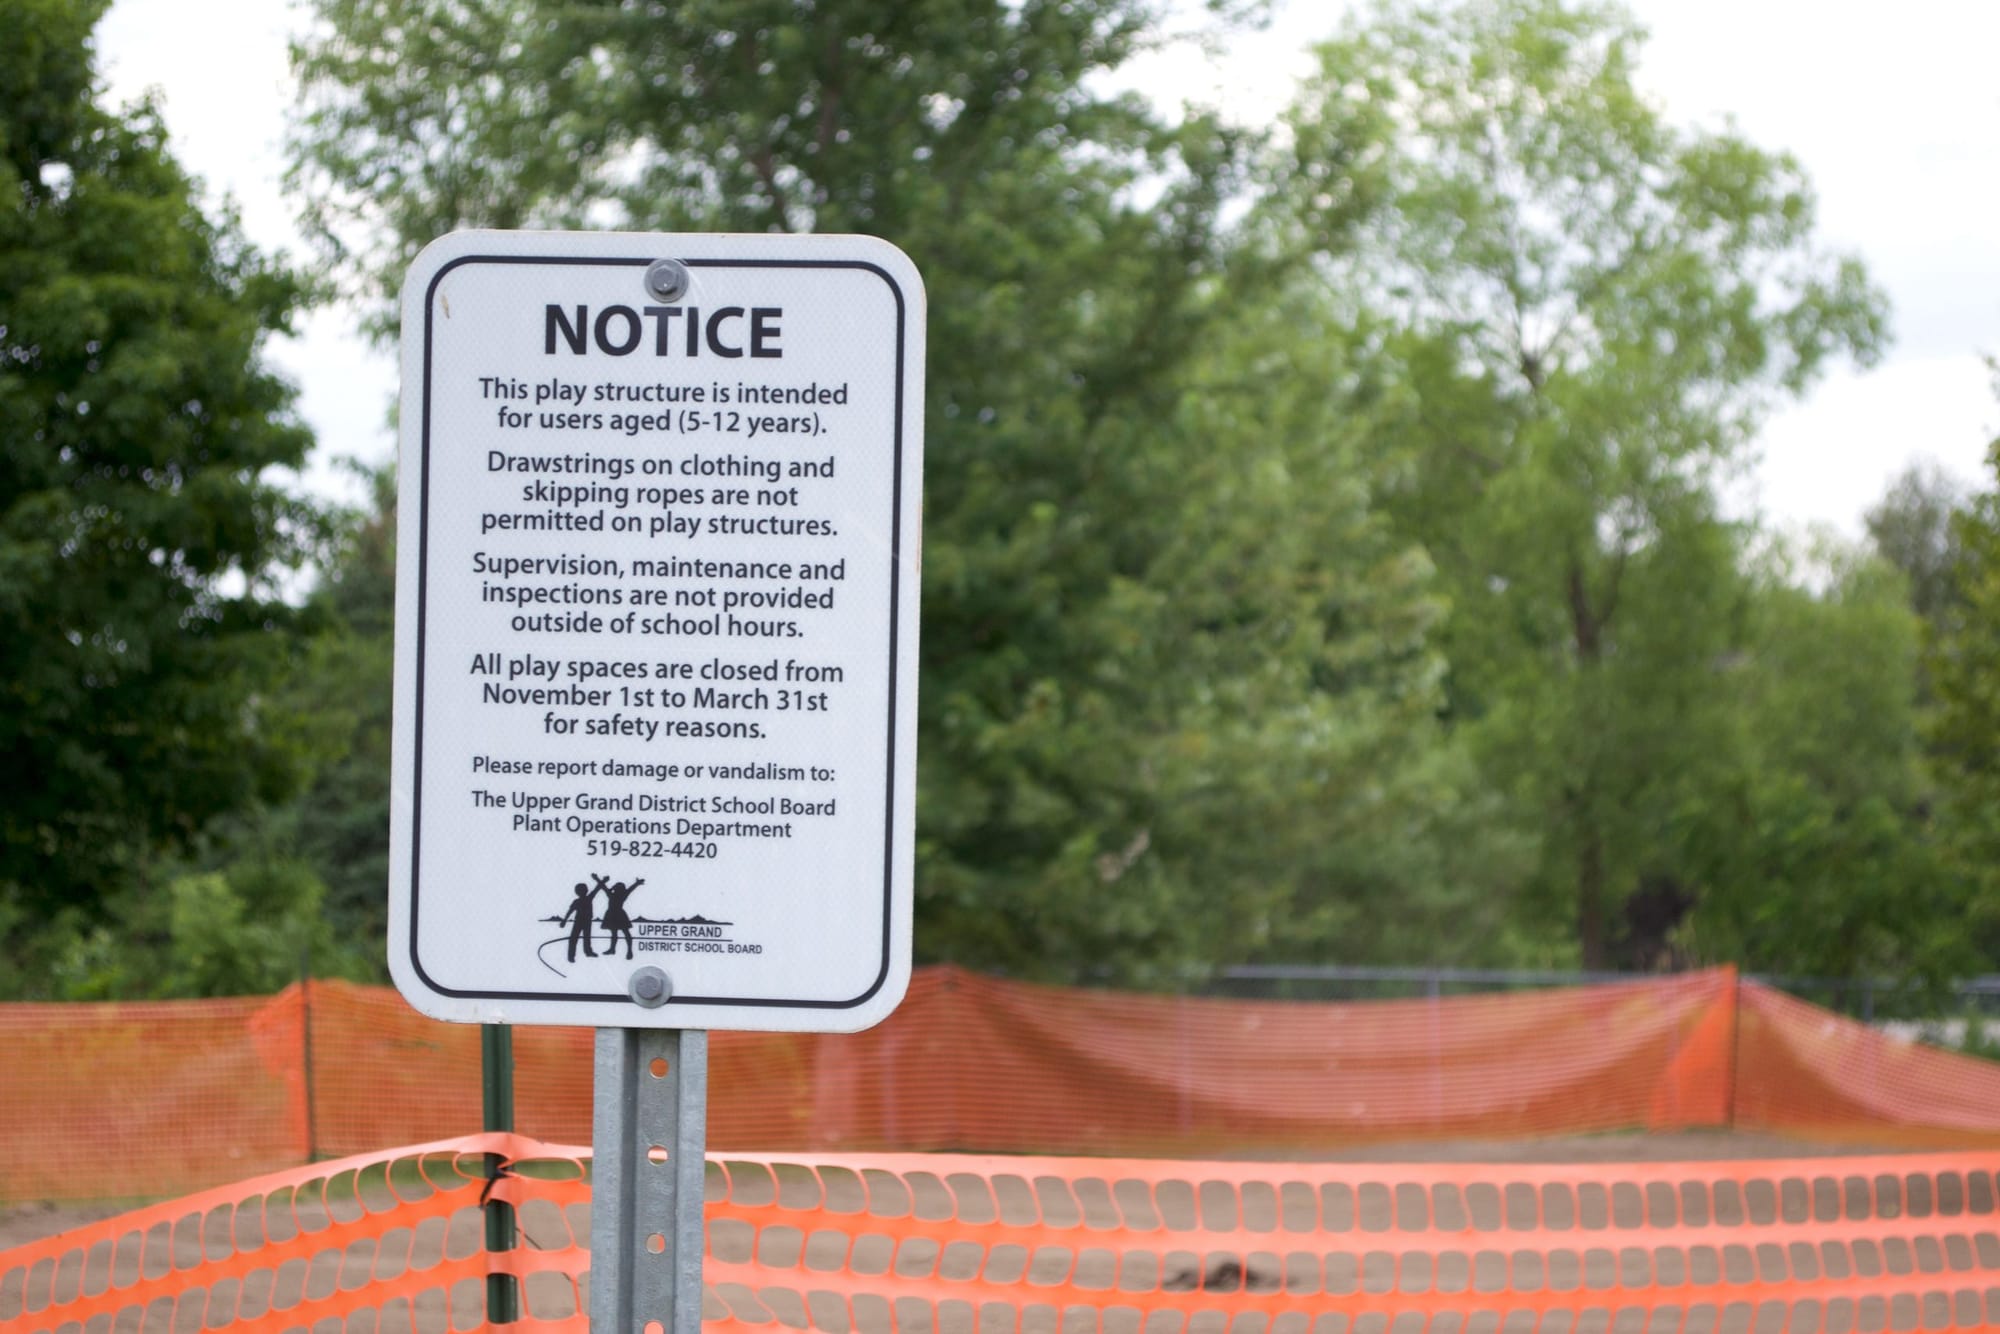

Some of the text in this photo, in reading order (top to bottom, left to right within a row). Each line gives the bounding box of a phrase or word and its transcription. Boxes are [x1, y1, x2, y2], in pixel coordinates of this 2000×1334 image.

[545, 304, 782, 358] NOTICE
[478, 377, 847, 406] This play structure is intended
[498, 405, 826, 438] for users aged (5-12 years).
[488, 450, 834, 483] Drawstrings on clothing and
[523, 479, 798, 510] skipping ropes are not
[482, 509, 837, 539] permitted on play structures.
[473, 552, 845, 580] Supervision, maintenance and
[483, 585, 834, 613] inspections are not provided
[511, 611, 803, 637] outside of school hours.
[470, 653, 843, 683] All play spaces are closed from
[483, 682, 828, 711] November 1st to March 31st
[544, 711, 766, 742] for safety reasons.
[473, 756, 835, 782] Please report damage or vandalism to:
[471, 790, 835, 816] The Upper Grand District School Board
[513, 814, 792, 840] Plant Operations Department
[587, 840, 717, 859] 519-822-4420
[639, 925, 722, 938] UPPER GRAND
[638, 941, 762, 954] DISTRICT SCHOOL BOARD
